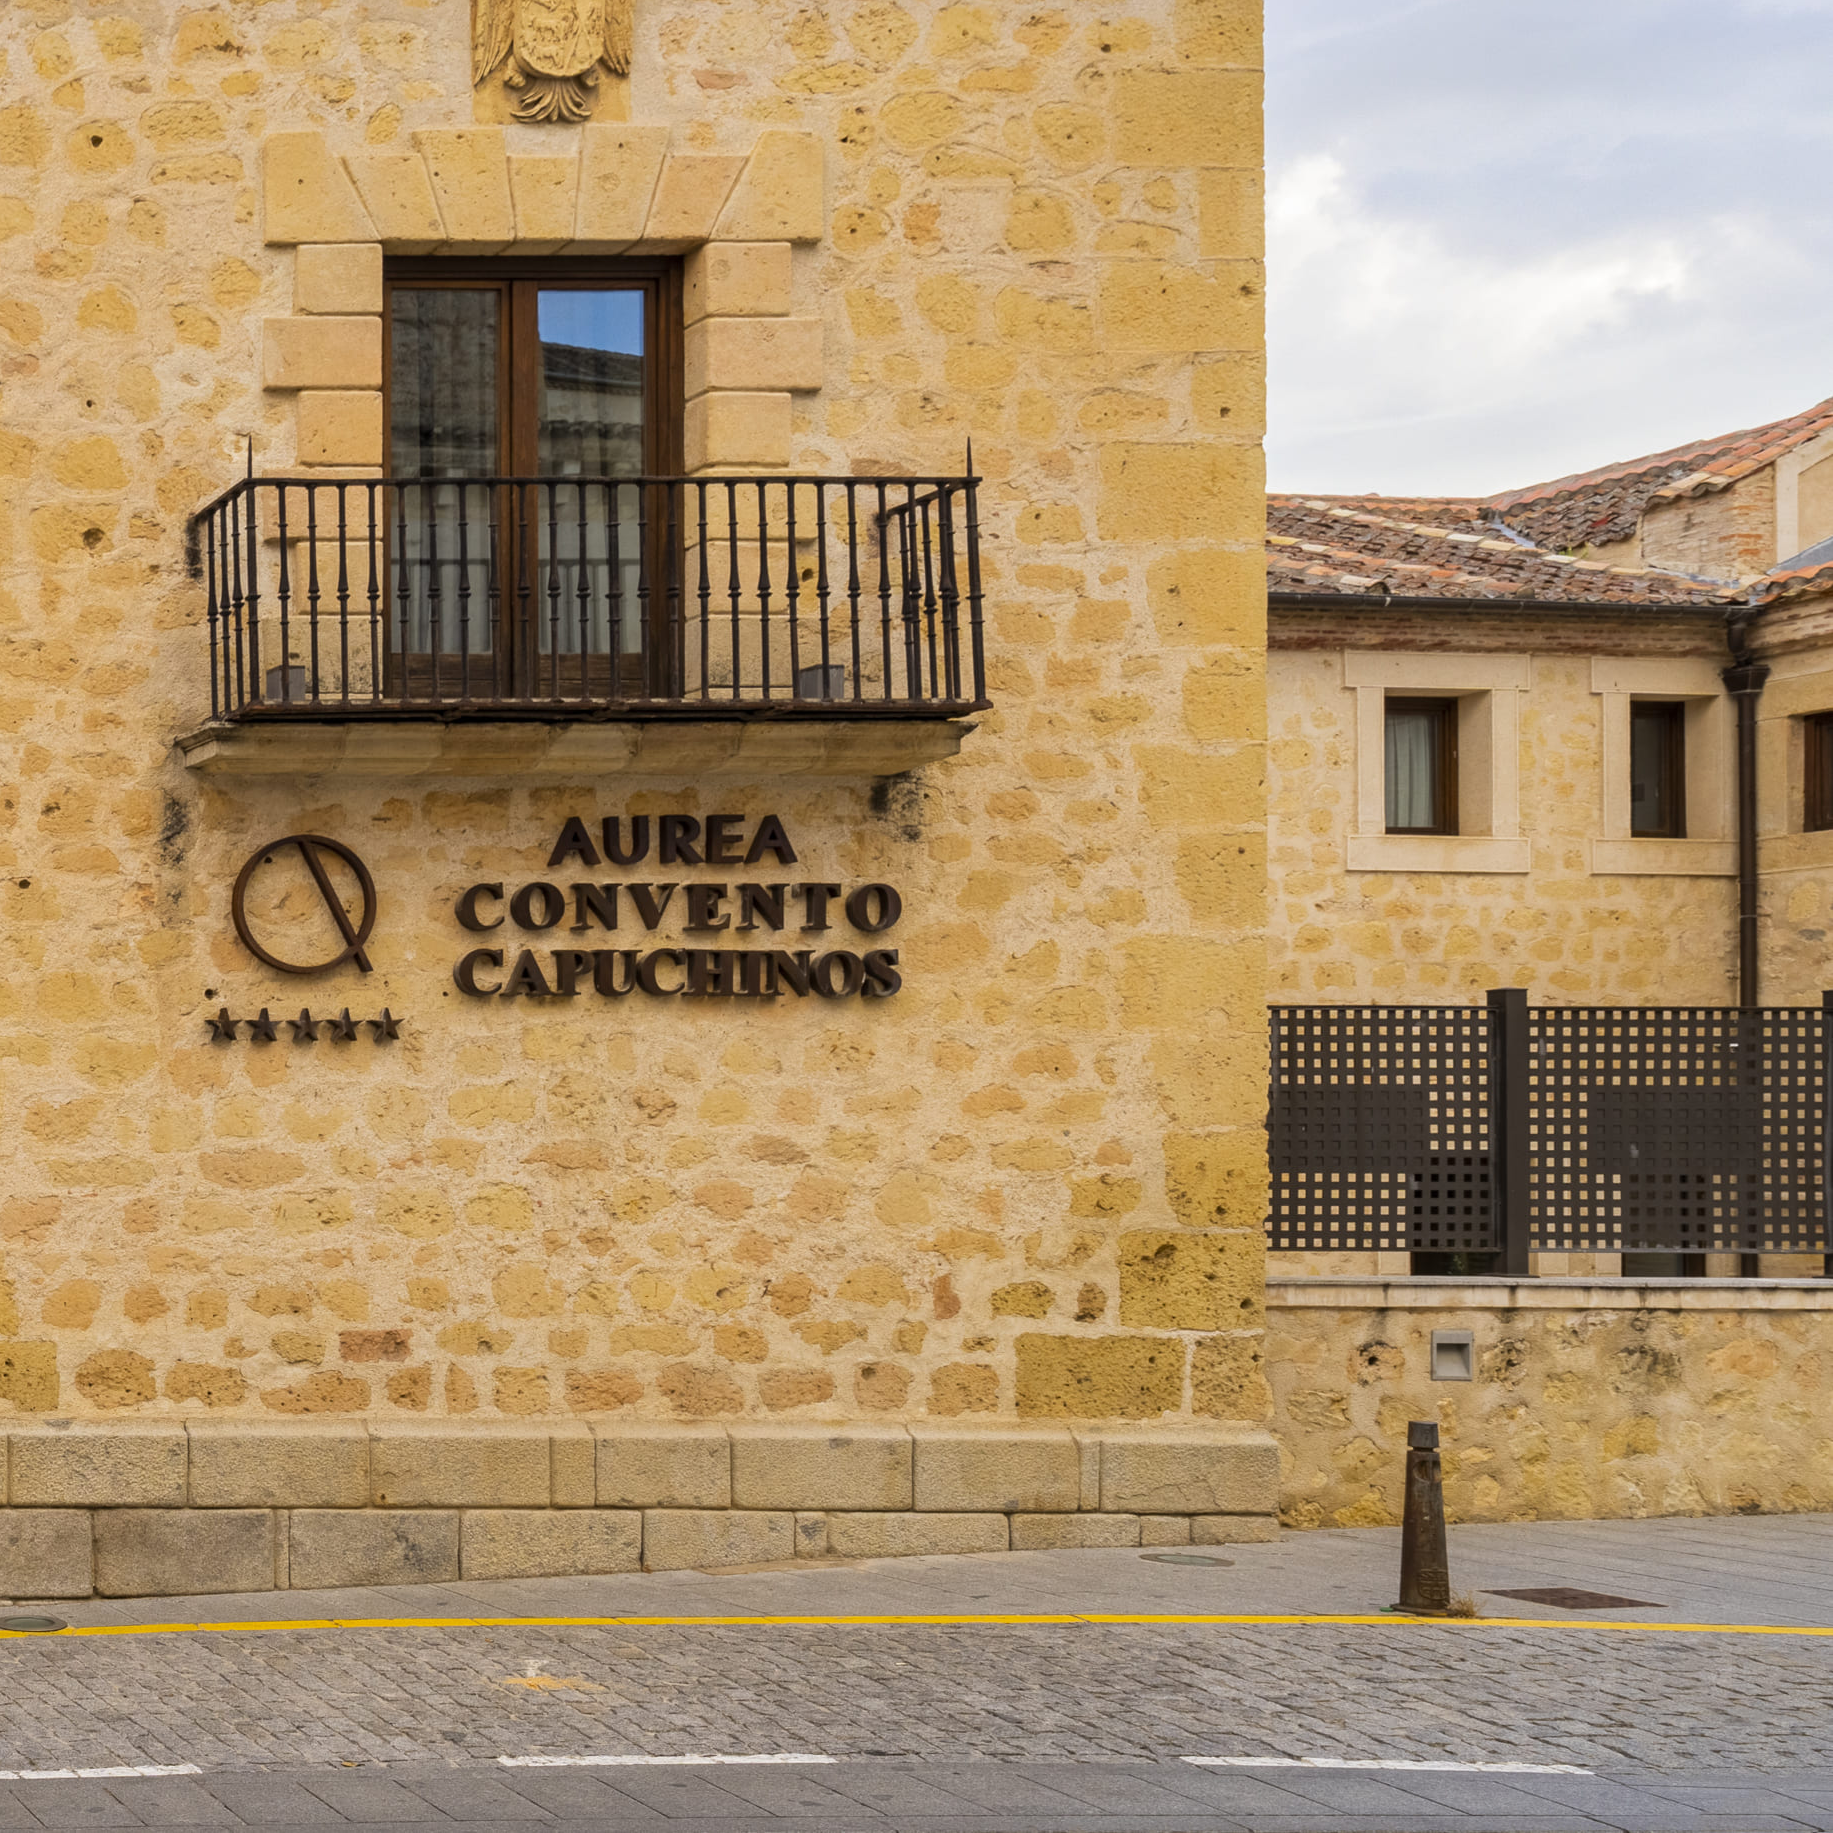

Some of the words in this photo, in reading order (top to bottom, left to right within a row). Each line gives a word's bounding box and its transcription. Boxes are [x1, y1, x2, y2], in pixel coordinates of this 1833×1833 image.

[547, 814, 798, 866] AUREA
[454, 882, 902, 932] CONVENTO
[453, 948, 902, 999] CAPUCHINOS
